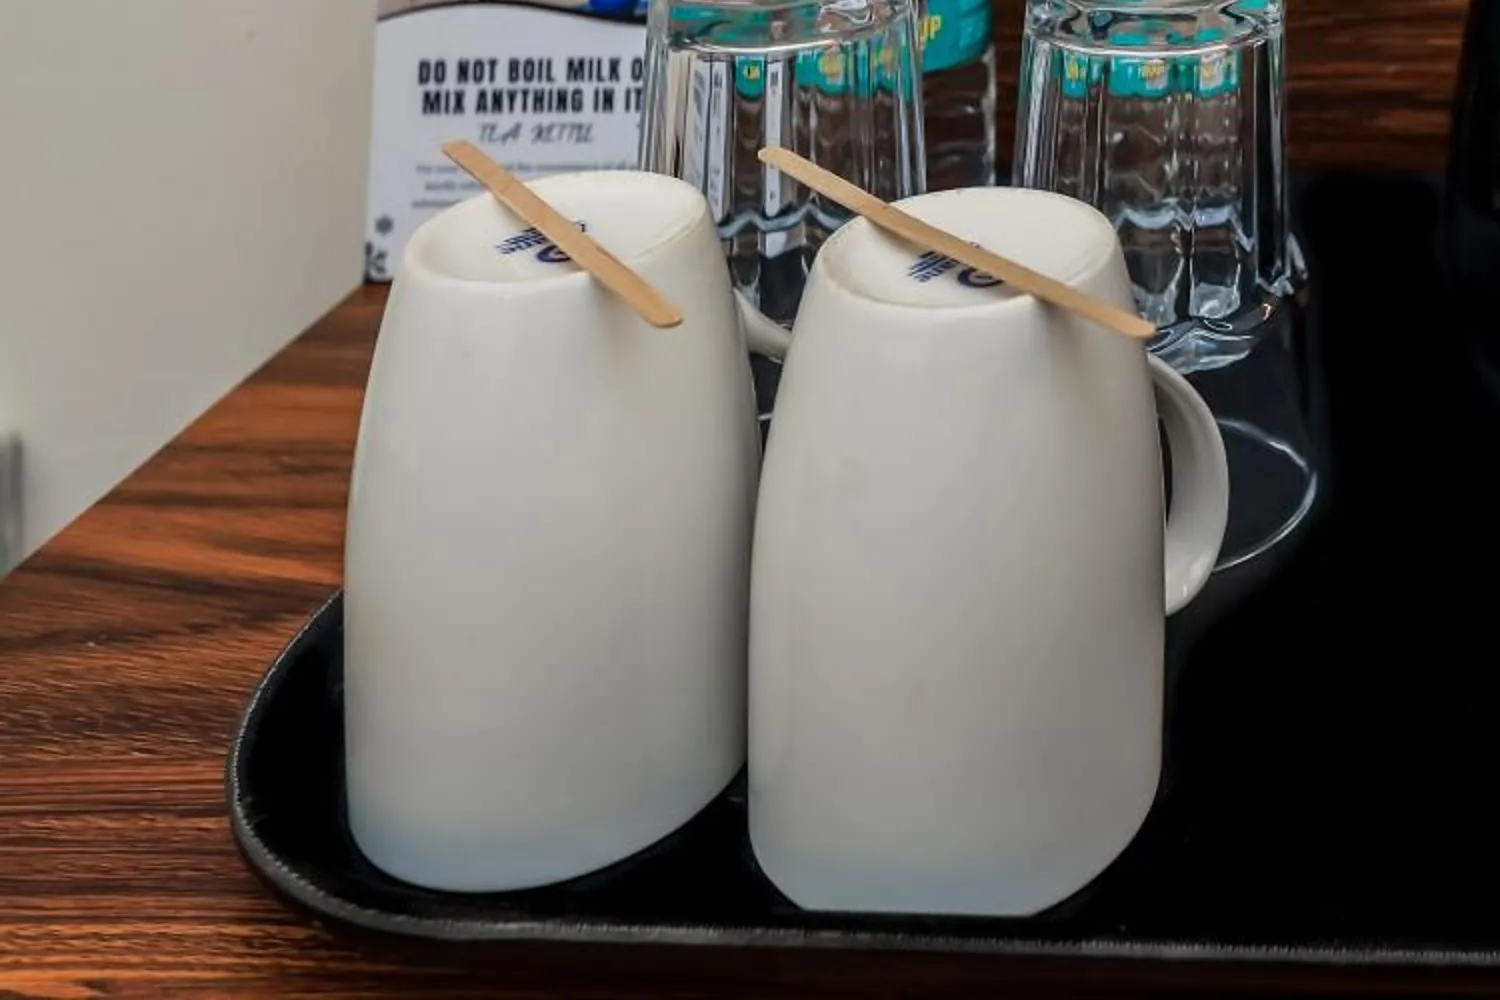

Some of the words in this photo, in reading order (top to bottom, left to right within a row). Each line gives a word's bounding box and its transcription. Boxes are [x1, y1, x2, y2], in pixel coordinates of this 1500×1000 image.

[418, 60, 447, 85] DO
[457, 58, 498, 84] NOT
[508, 58, 555, 83] BOIL
[566, 57, 621, 83] MILK
[422, 89, 465, 115] MIX
[475, 88, 584, 114] ANYTHING
[594, 88, 614, 113] IN
[480, 122, 522, 145] TEA
